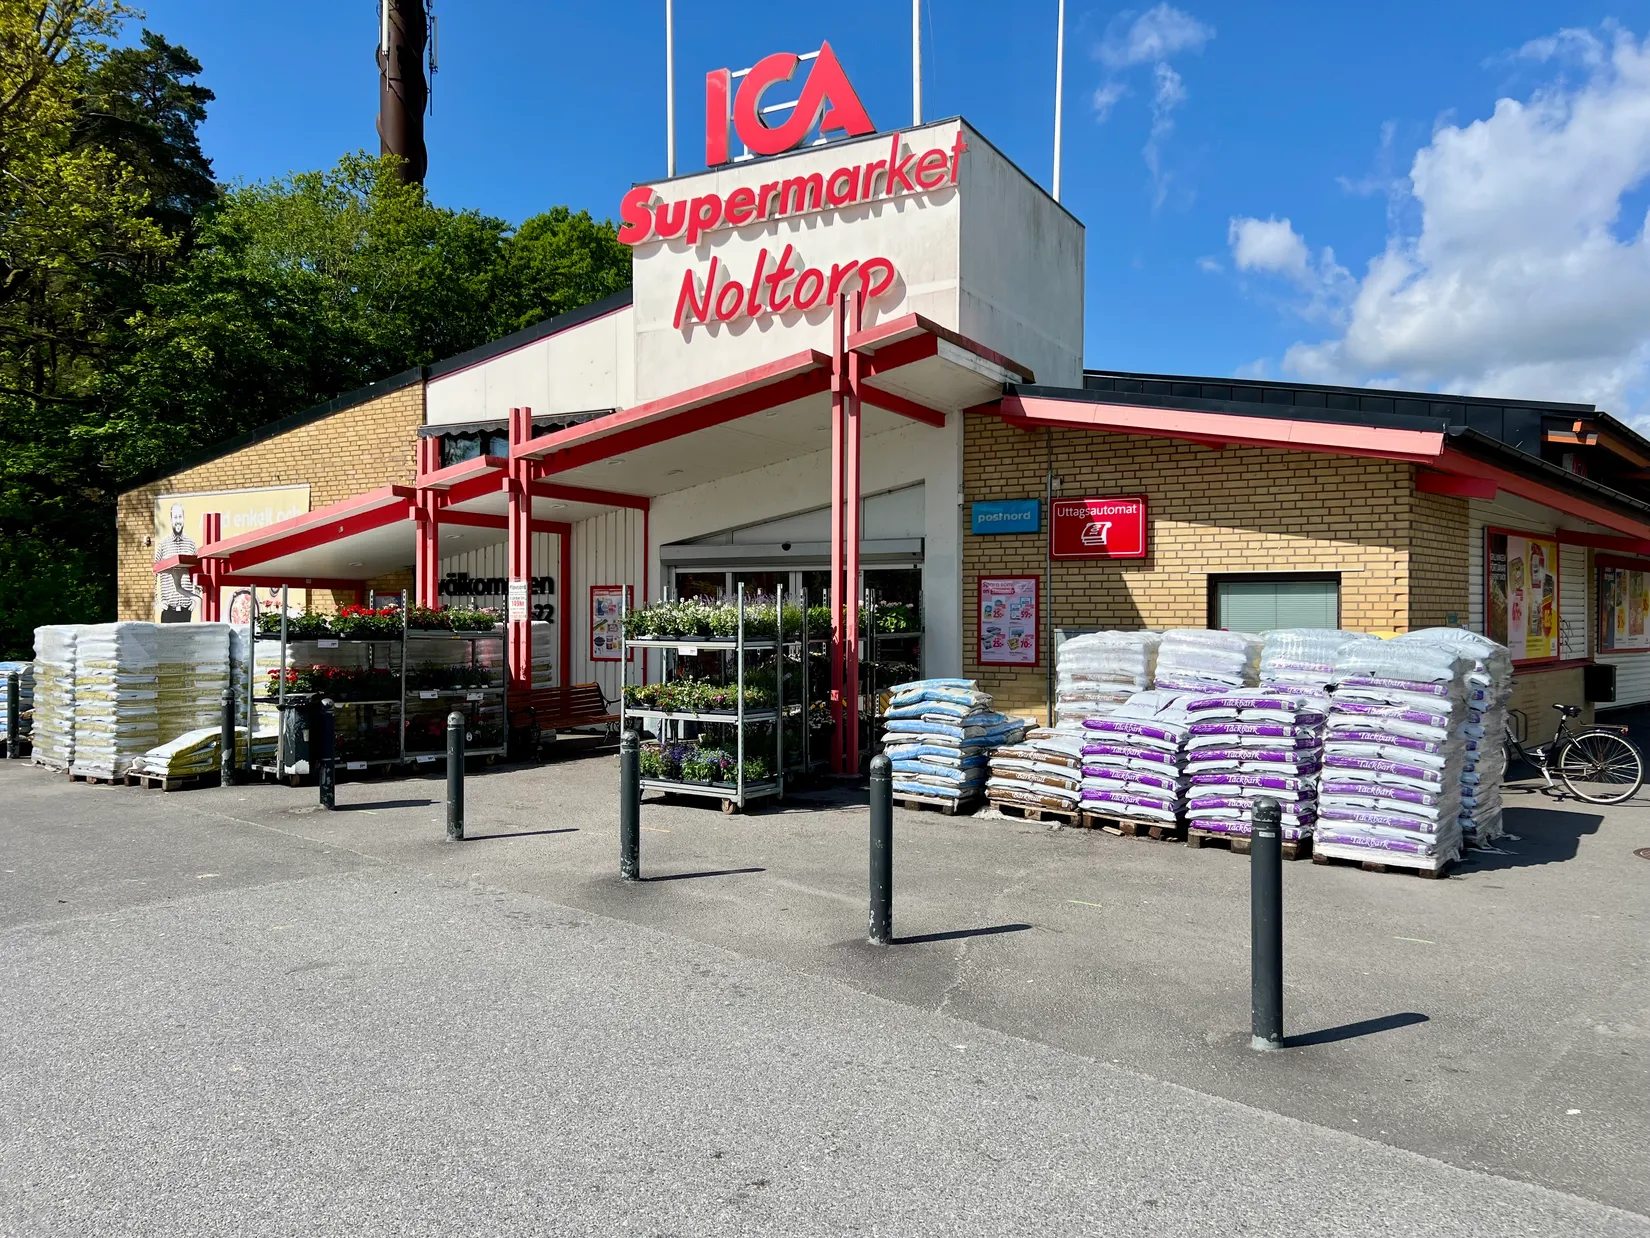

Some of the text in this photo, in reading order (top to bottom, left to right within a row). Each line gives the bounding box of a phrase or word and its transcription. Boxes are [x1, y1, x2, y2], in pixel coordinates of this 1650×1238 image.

[706, 40, 877, 166] ICA
[617, 130, 968, 245] Supermarket
[673, 243, 896, 329] Noltorp
[233, 507, 273, 527] enkelt
[978, 511, 1030, 523] postnord
[1057, 504, 1137, 519] Uttagsautomat
